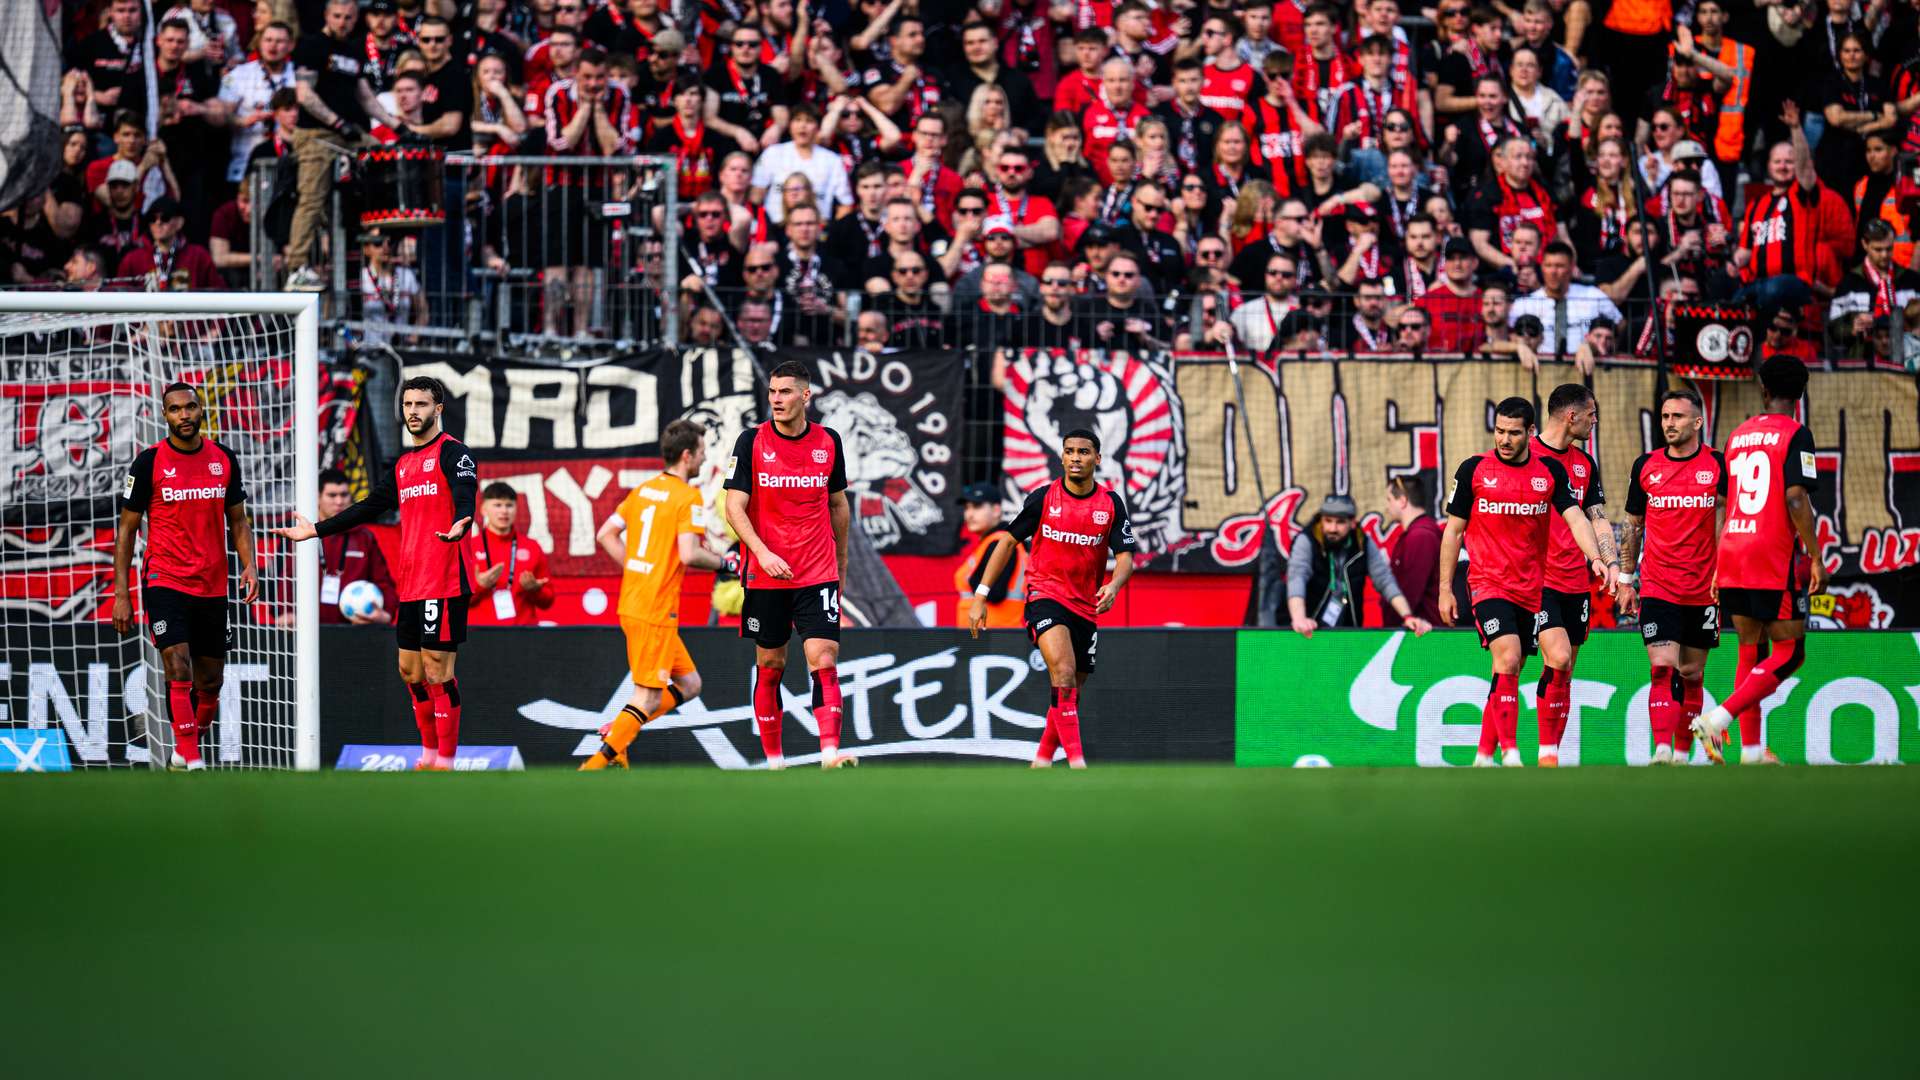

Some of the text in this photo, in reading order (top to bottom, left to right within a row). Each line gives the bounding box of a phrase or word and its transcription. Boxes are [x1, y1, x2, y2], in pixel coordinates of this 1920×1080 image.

[757, 472, 829, 488] Barmenia
[1729, 450, 1771, 515] 19
[162, 484, 227, 502] Barmenia
[1648, 492, 1715, 509] Barmenia
[1478, 498, 1548, 516] Barmenia
[637, 505, 656, 558] 1
[820, 587, 840, 613] 14
[424, 599, 439, 622] 5
